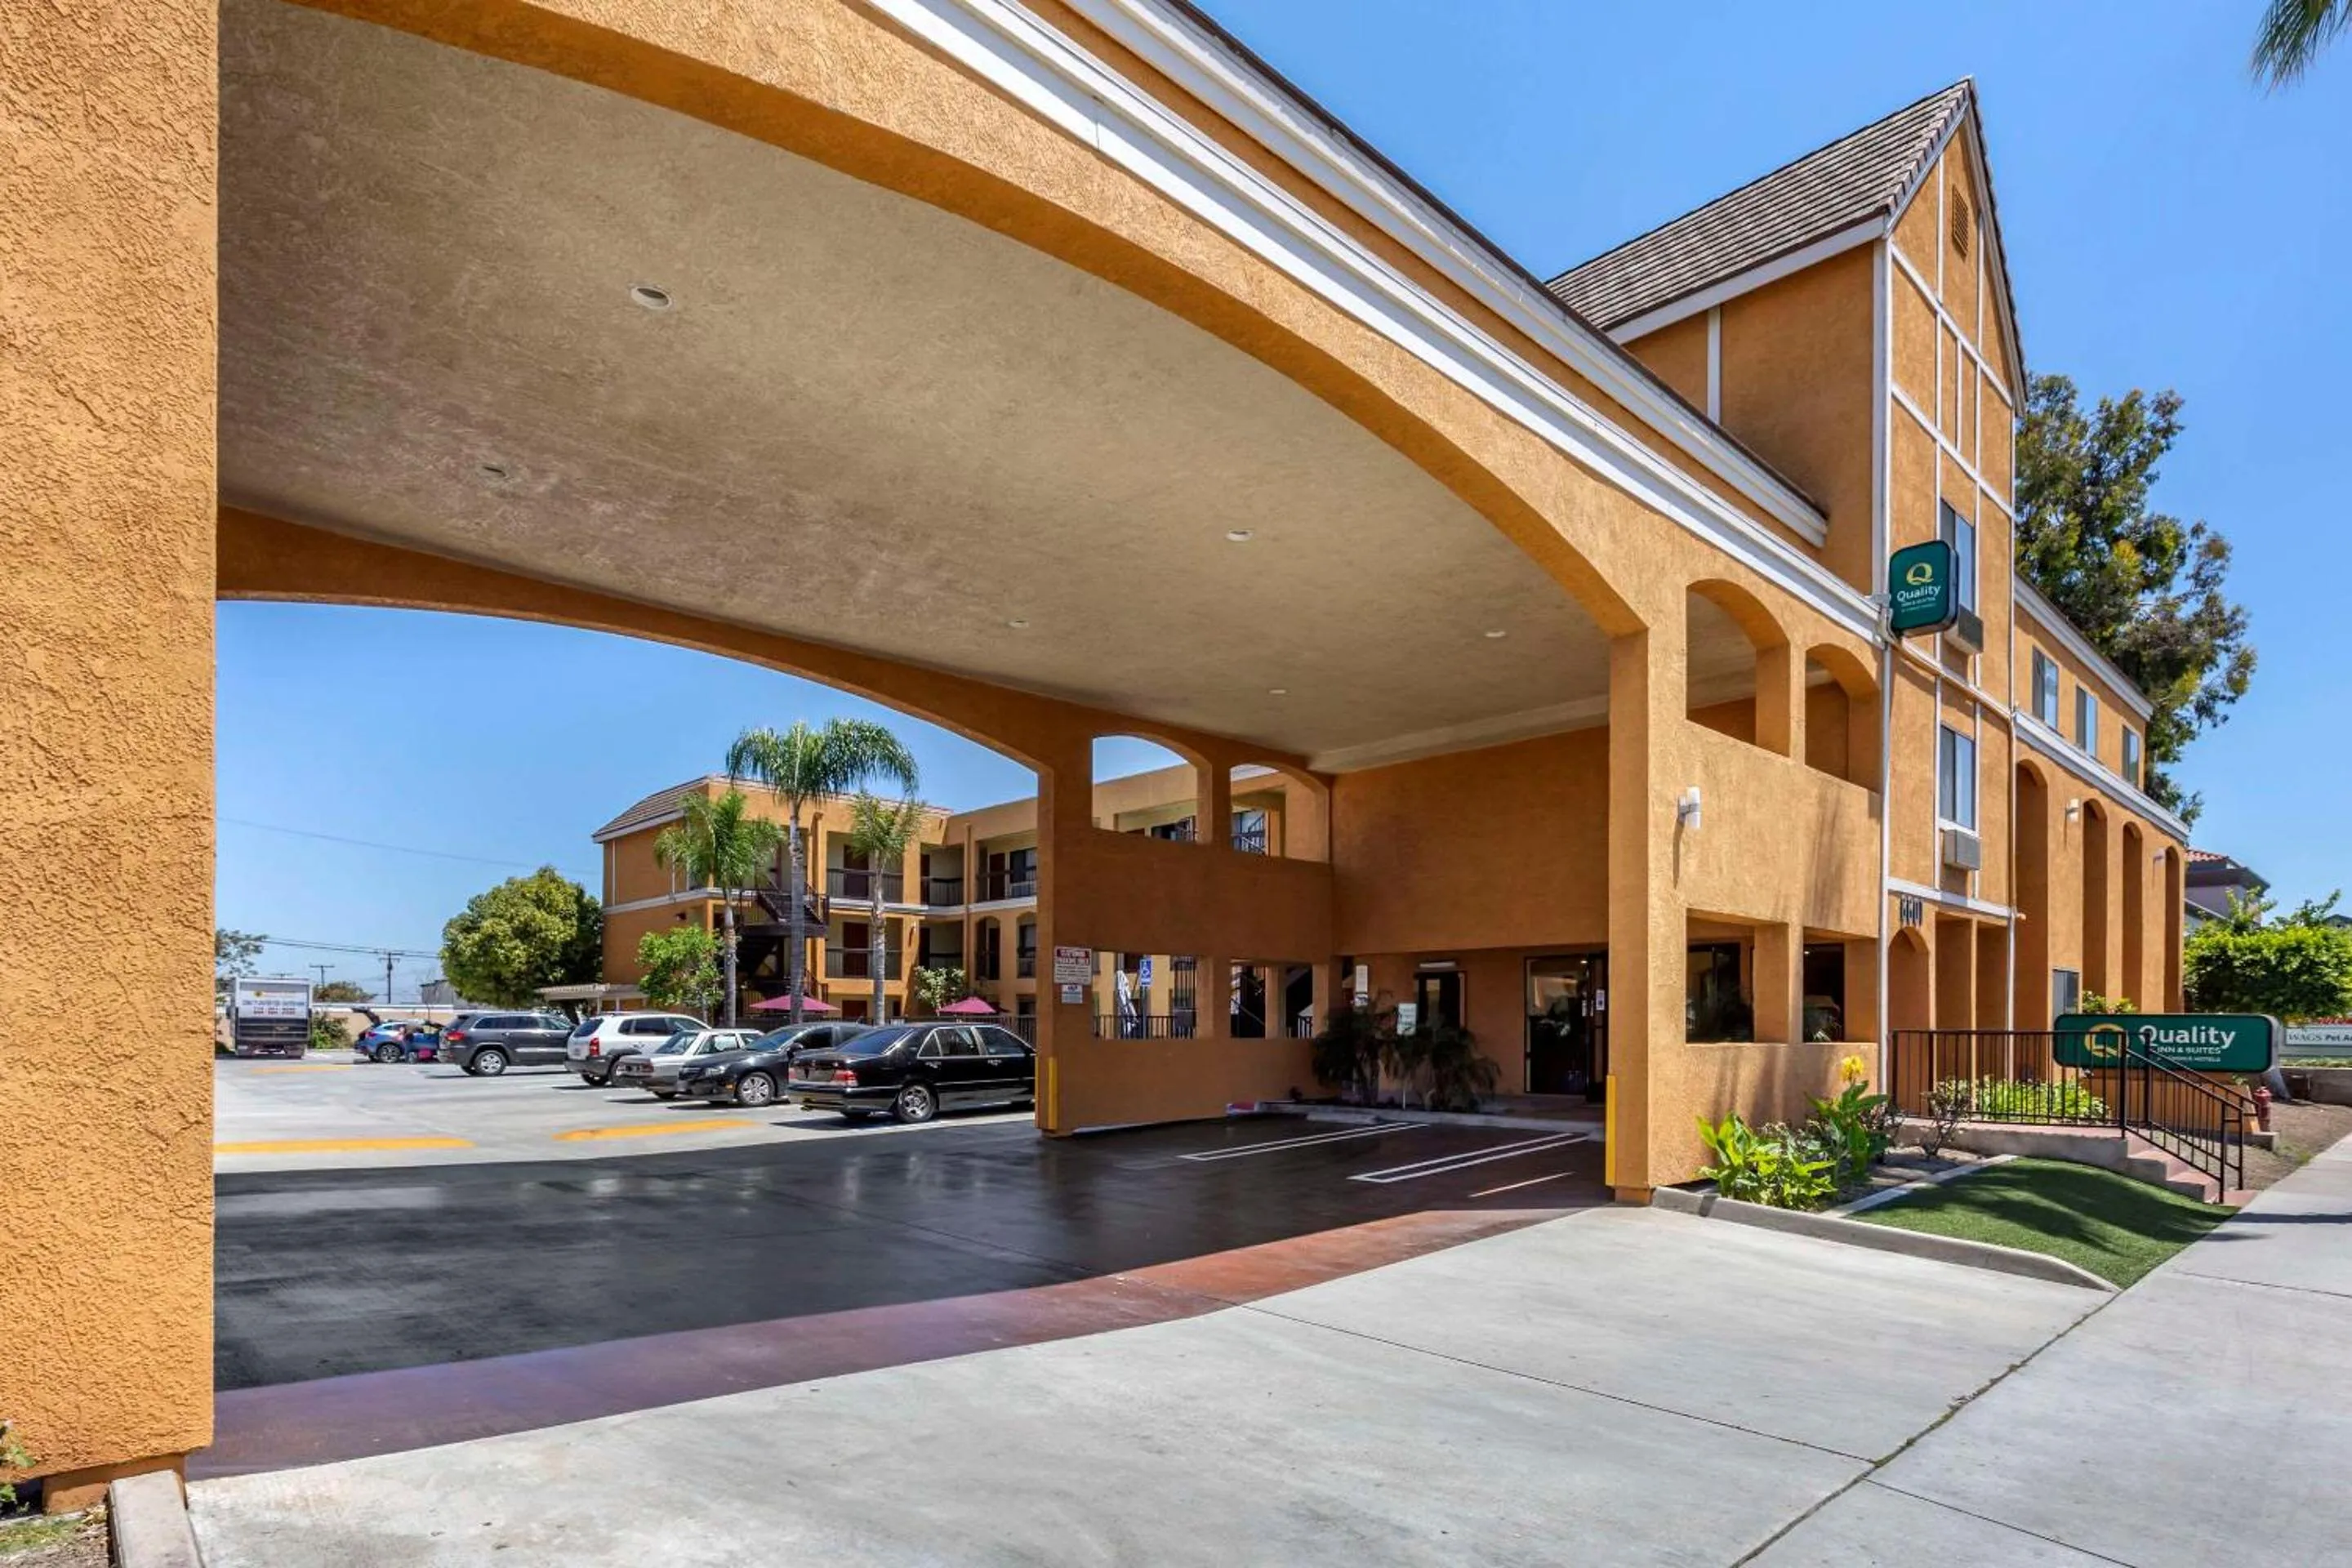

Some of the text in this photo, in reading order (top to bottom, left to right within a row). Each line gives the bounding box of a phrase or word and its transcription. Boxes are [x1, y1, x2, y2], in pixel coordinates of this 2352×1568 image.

[1896, 585, 1941, 603] Quality
[2138, 1025, 2236, 1049] Quality
[2287, 1032, 2323, 1041] WAGS
[2325, 1034, 2340, 1042] Pet
